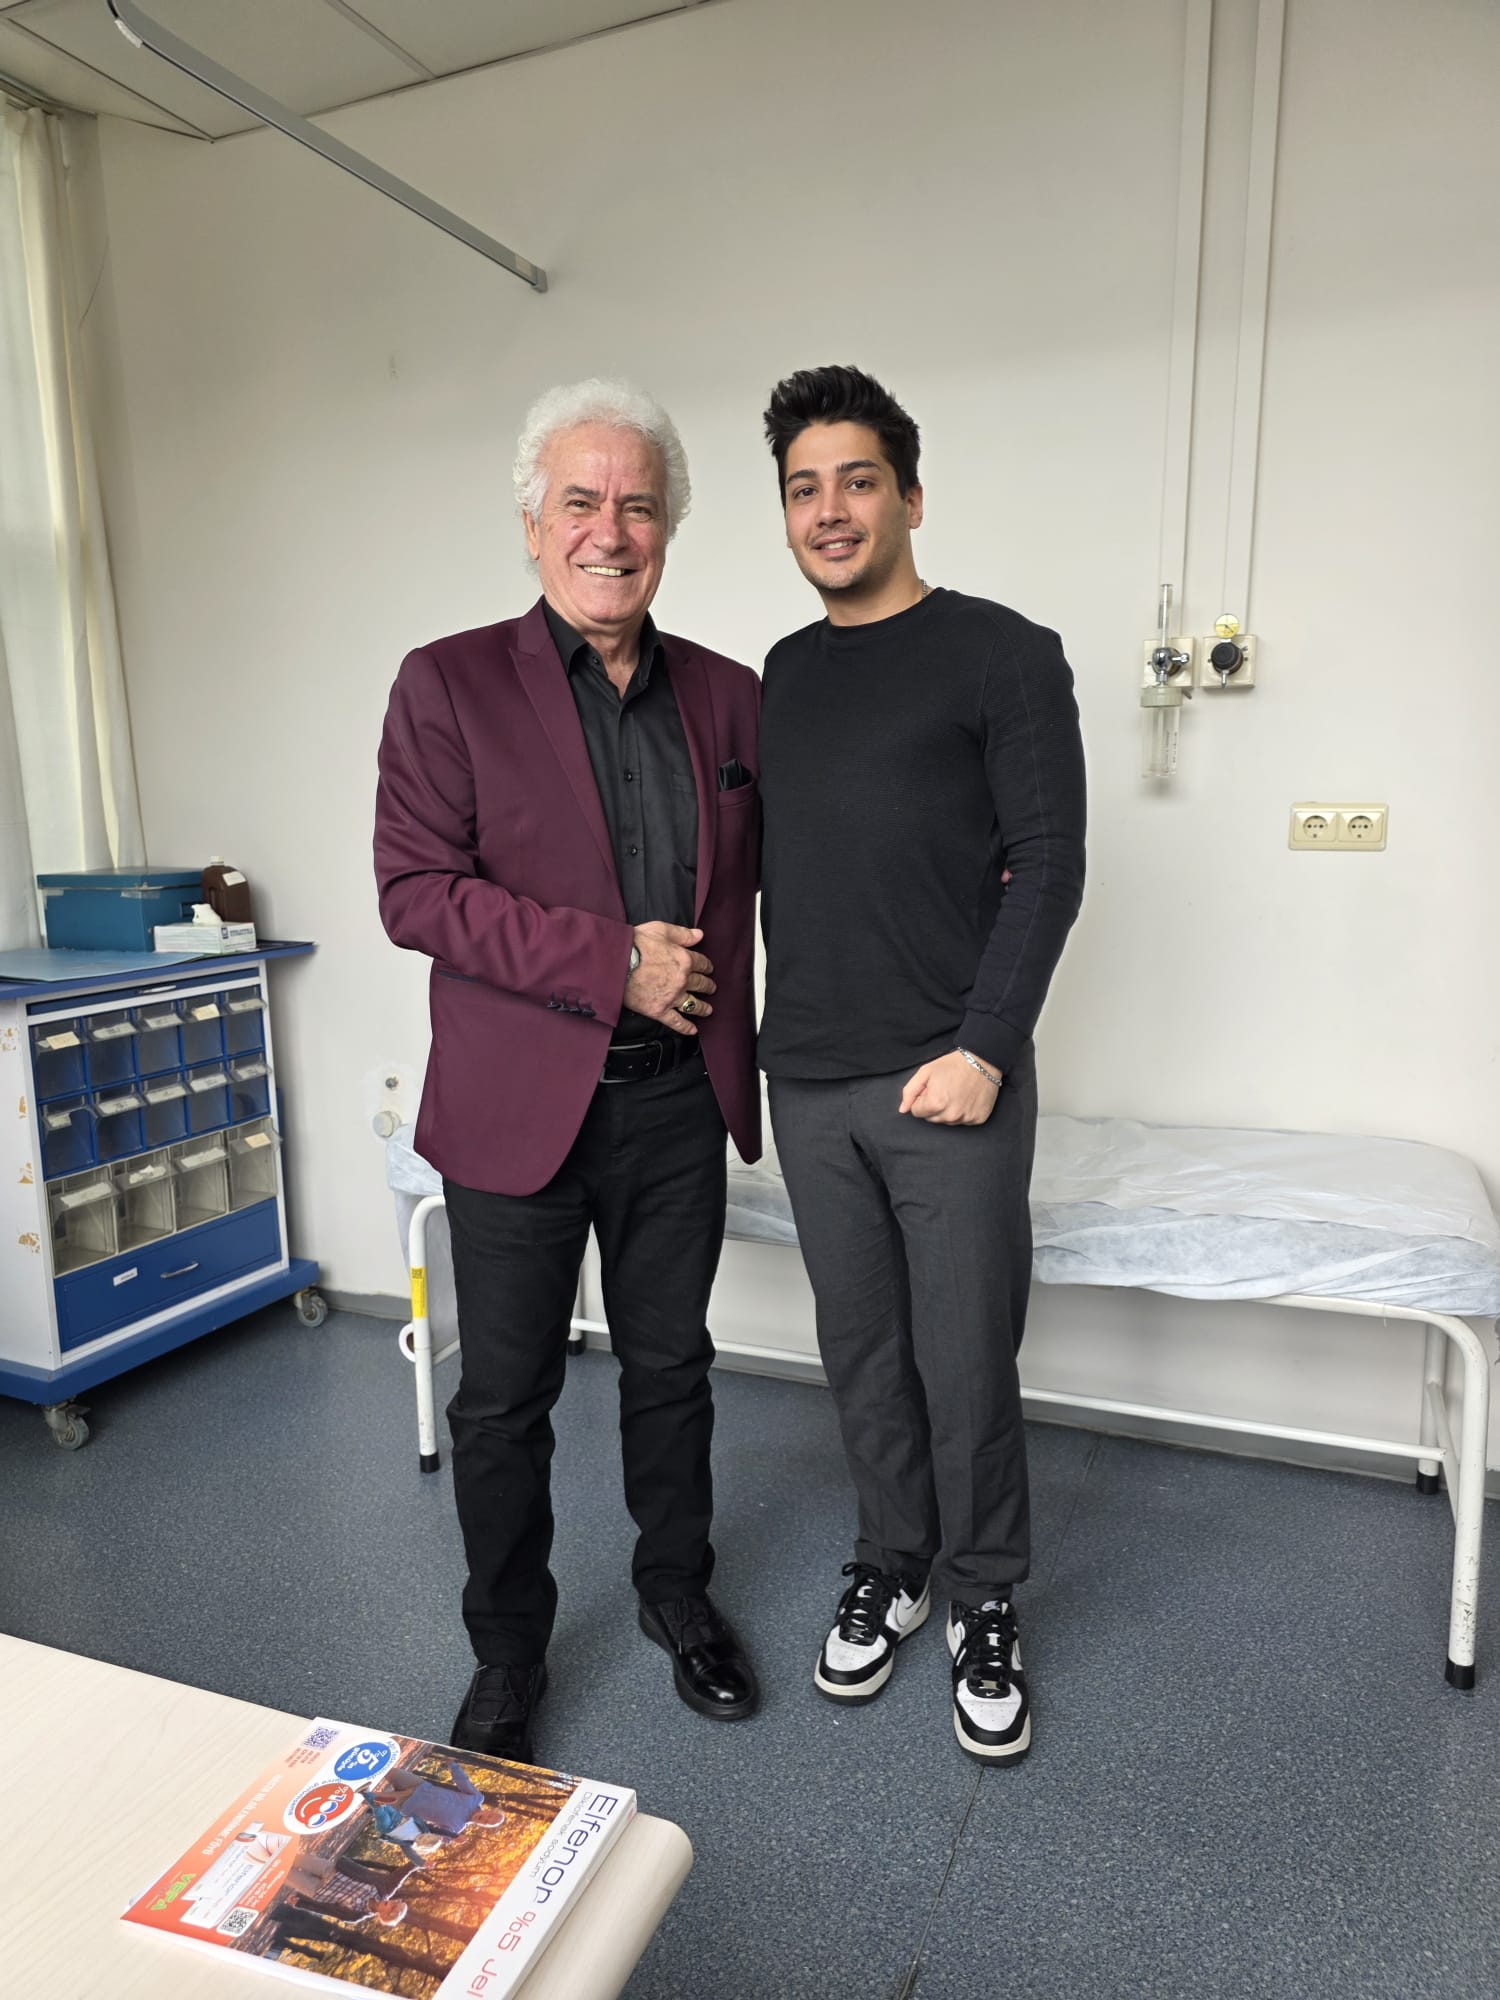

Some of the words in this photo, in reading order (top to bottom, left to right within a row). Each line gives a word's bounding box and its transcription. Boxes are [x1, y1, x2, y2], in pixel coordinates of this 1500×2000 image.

[560, 1792, 593, 1836] Diklofenak
[530, 1839, 559, 1878] sodyum
[536, 1794, 619, 1903] Elfenor
[150, 1873, 197, 1911] VEFA
[498, 1911, 536, 1951] %5
[467, 1958, 497, 1998] Jel
